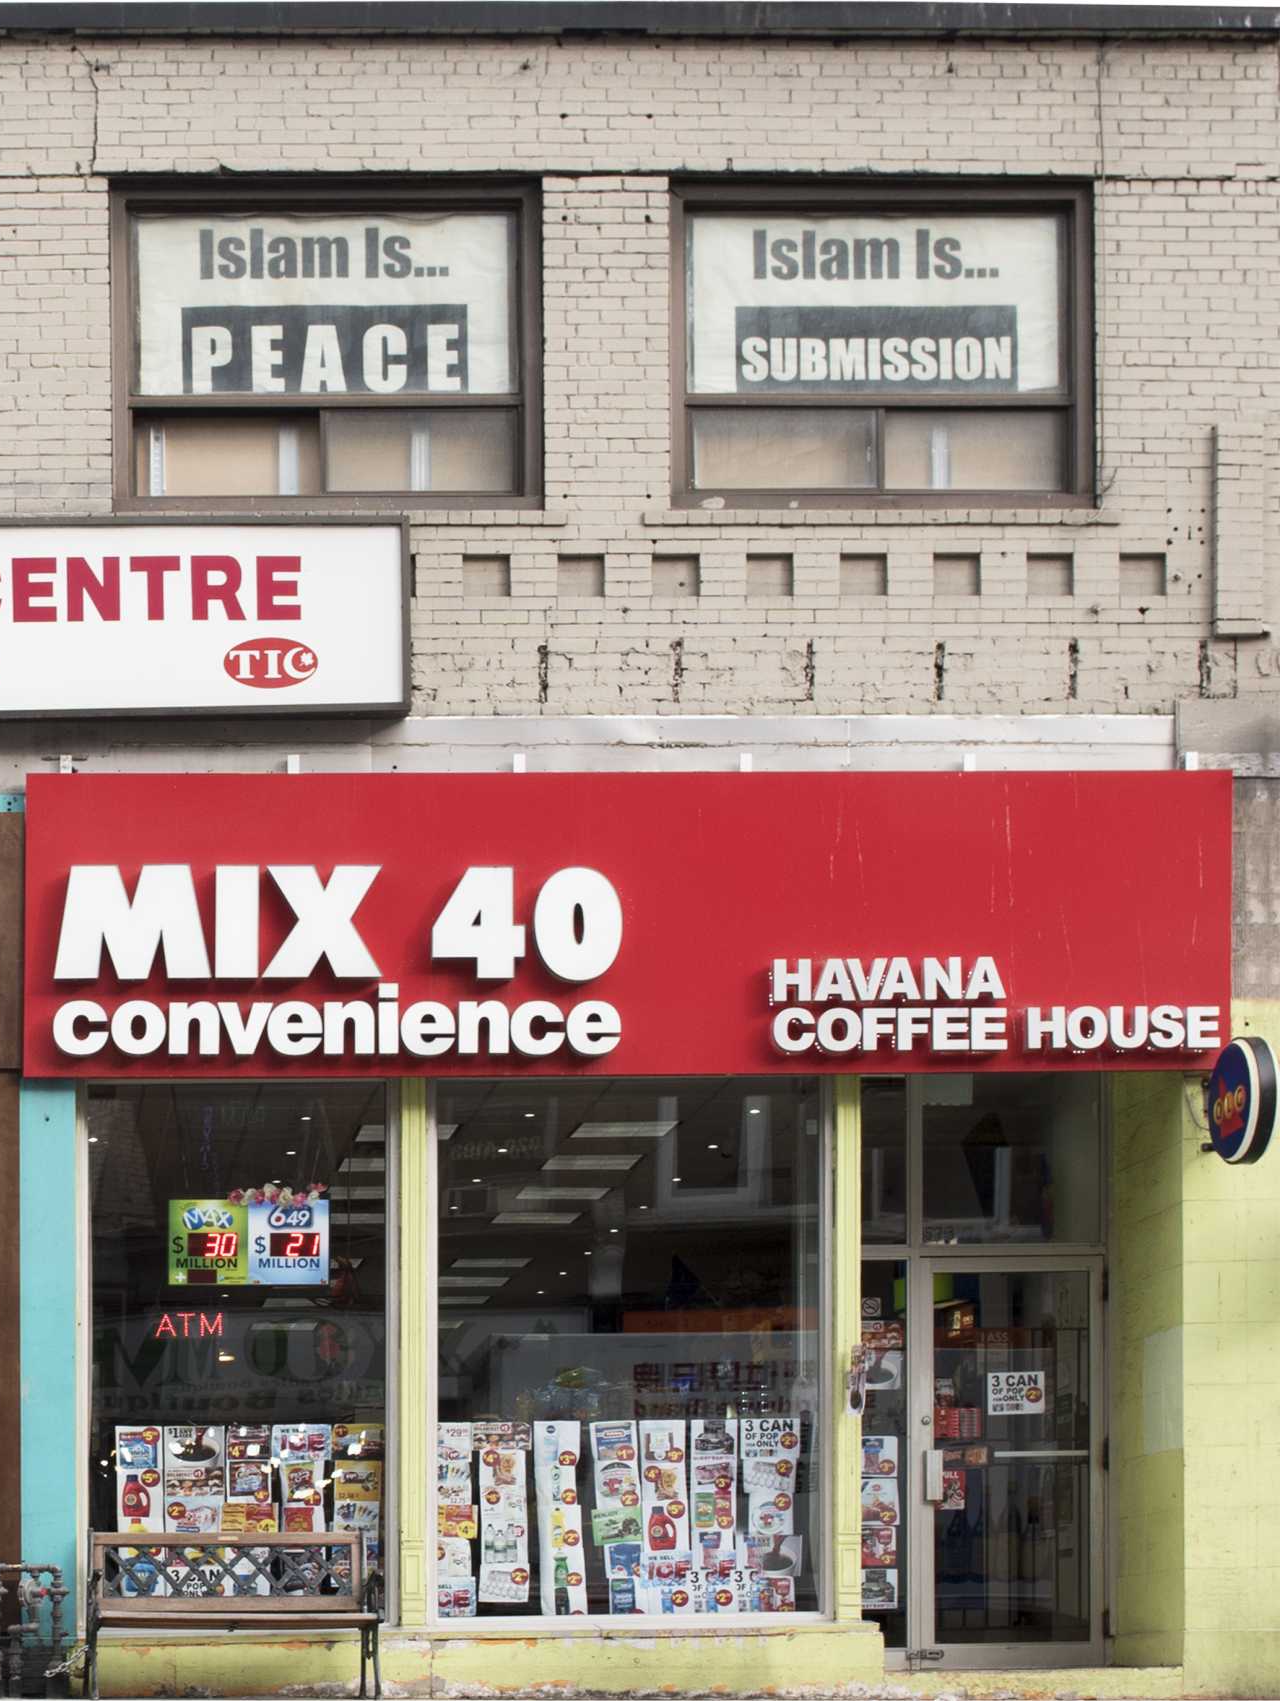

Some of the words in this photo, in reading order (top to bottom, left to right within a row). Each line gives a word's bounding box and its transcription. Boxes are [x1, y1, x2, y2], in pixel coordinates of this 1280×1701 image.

[199, 228, 348, 280] Islam
[365, 227, 449, 279] Is...
[753, 229, 900, 280] Islam
[916, 229, 999, 279] Is...
[192, 323, 461, 393] PEACE
[741, 336, 1012, 381] SUBMISSION
[227, 648, 317, 681] TIC
[53, 863, 382, 980] MIX
[432, 865, 623, 983] 40
[770, 956, 1008, 1004] HAVANA
[52, 982, 622, 1058] convenience
[772, 1006, 1008, 1053] COFFEE
[1027, 1005, 1222, 1052] HOUSE
[183, 1207, 232, 1230] MAX
[204, 1233, 238, 1257] 30
[285, 1233, 320, 1257] 21
[923, 1226, 955, 1242] 573
[176, 1258, 238, 1268] MILLION
[258, 1258, 320, 1268] MILLION
[156, 1312, 222, 1337] ATM
[992, 1375, 1000, 1387] 3
[1005, 1374, 1038, 1387] CAN
[1003, 1394, 1025, 1402] ONLY
[745, 1420, 754, 1431] 3
[759, 1420, 793, 1431] CAN
[745, 1432, 757, 1440] OF
[760, 1432, 778, 1440] POP
[648, 1560, 692, 1580] ICE
